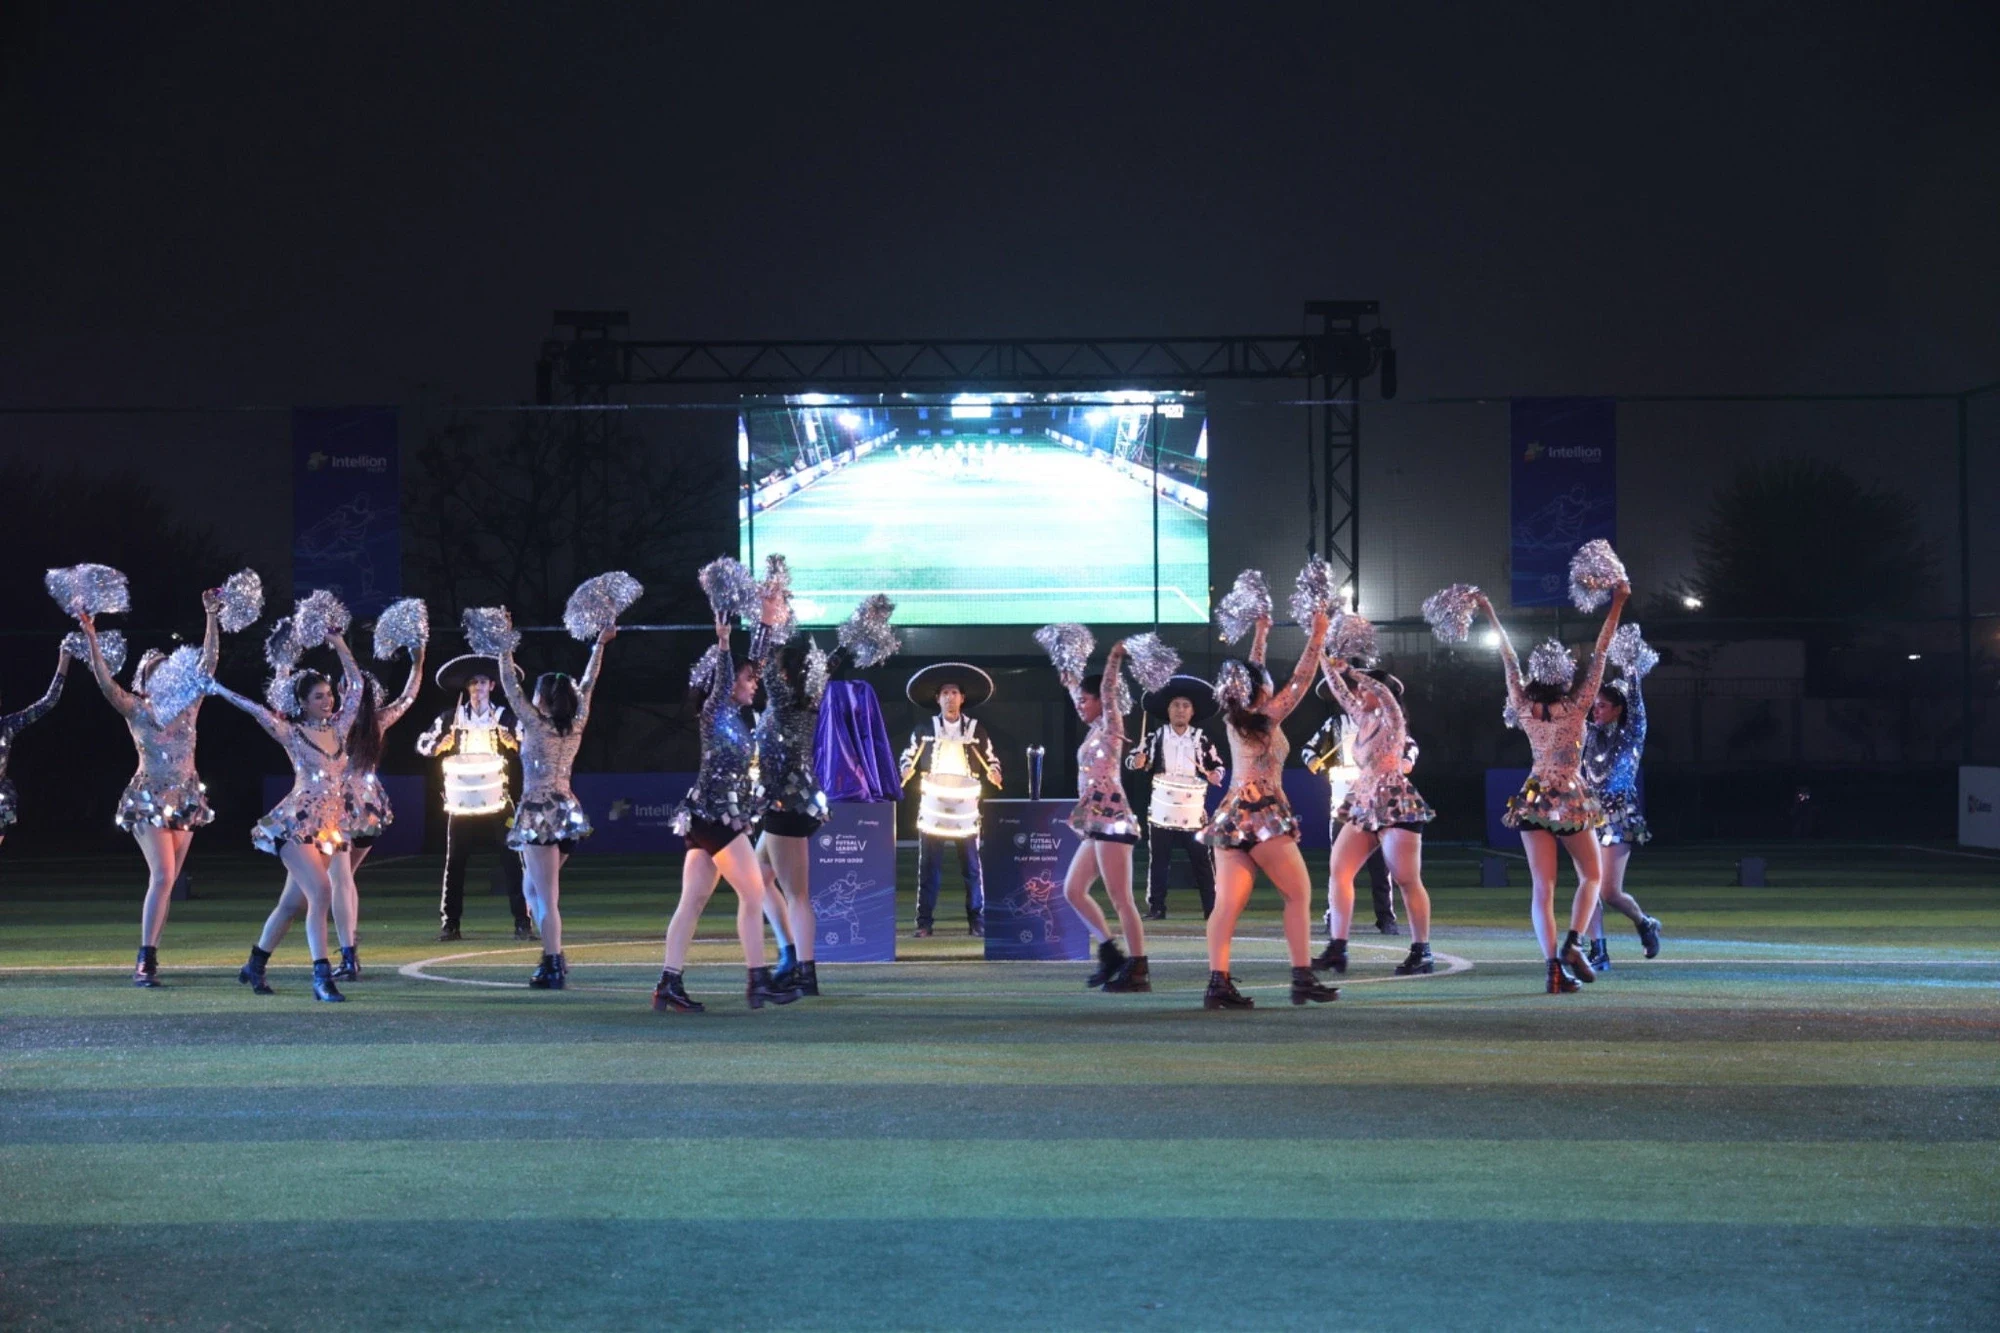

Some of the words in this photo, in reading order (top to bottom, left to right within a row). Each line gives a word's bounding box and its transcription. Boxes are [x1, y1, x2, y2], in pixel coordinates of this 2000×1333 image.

[1548, 445, 1602, 458] Intellion
[332, 455, 387, 468] Intellion
[857, 840, 868, 851] V
[1052, 838, 1062, 850] V
